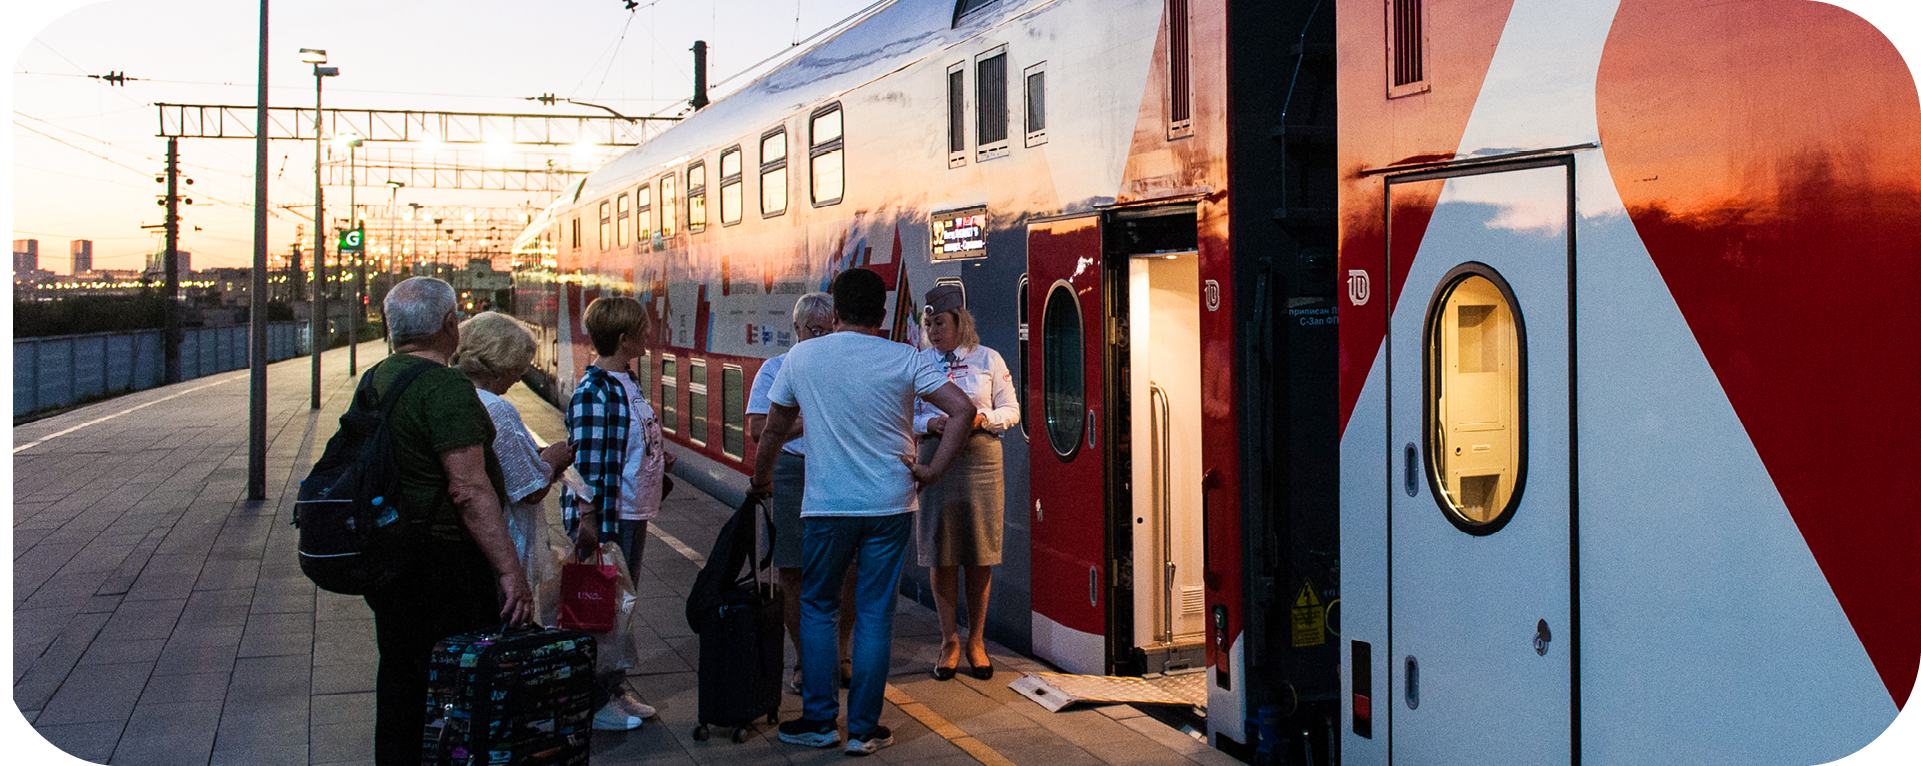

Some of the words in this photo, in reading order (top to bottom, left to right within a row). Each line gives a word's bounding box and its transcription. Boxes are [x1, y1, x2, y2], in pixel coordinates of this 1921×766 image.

[346, 231, 360, 246] G
[934, 221, 944, 245] 32
[1288, 308, 1330, 317] приписан
[1299, 317, 1324, 326] С-Зап
